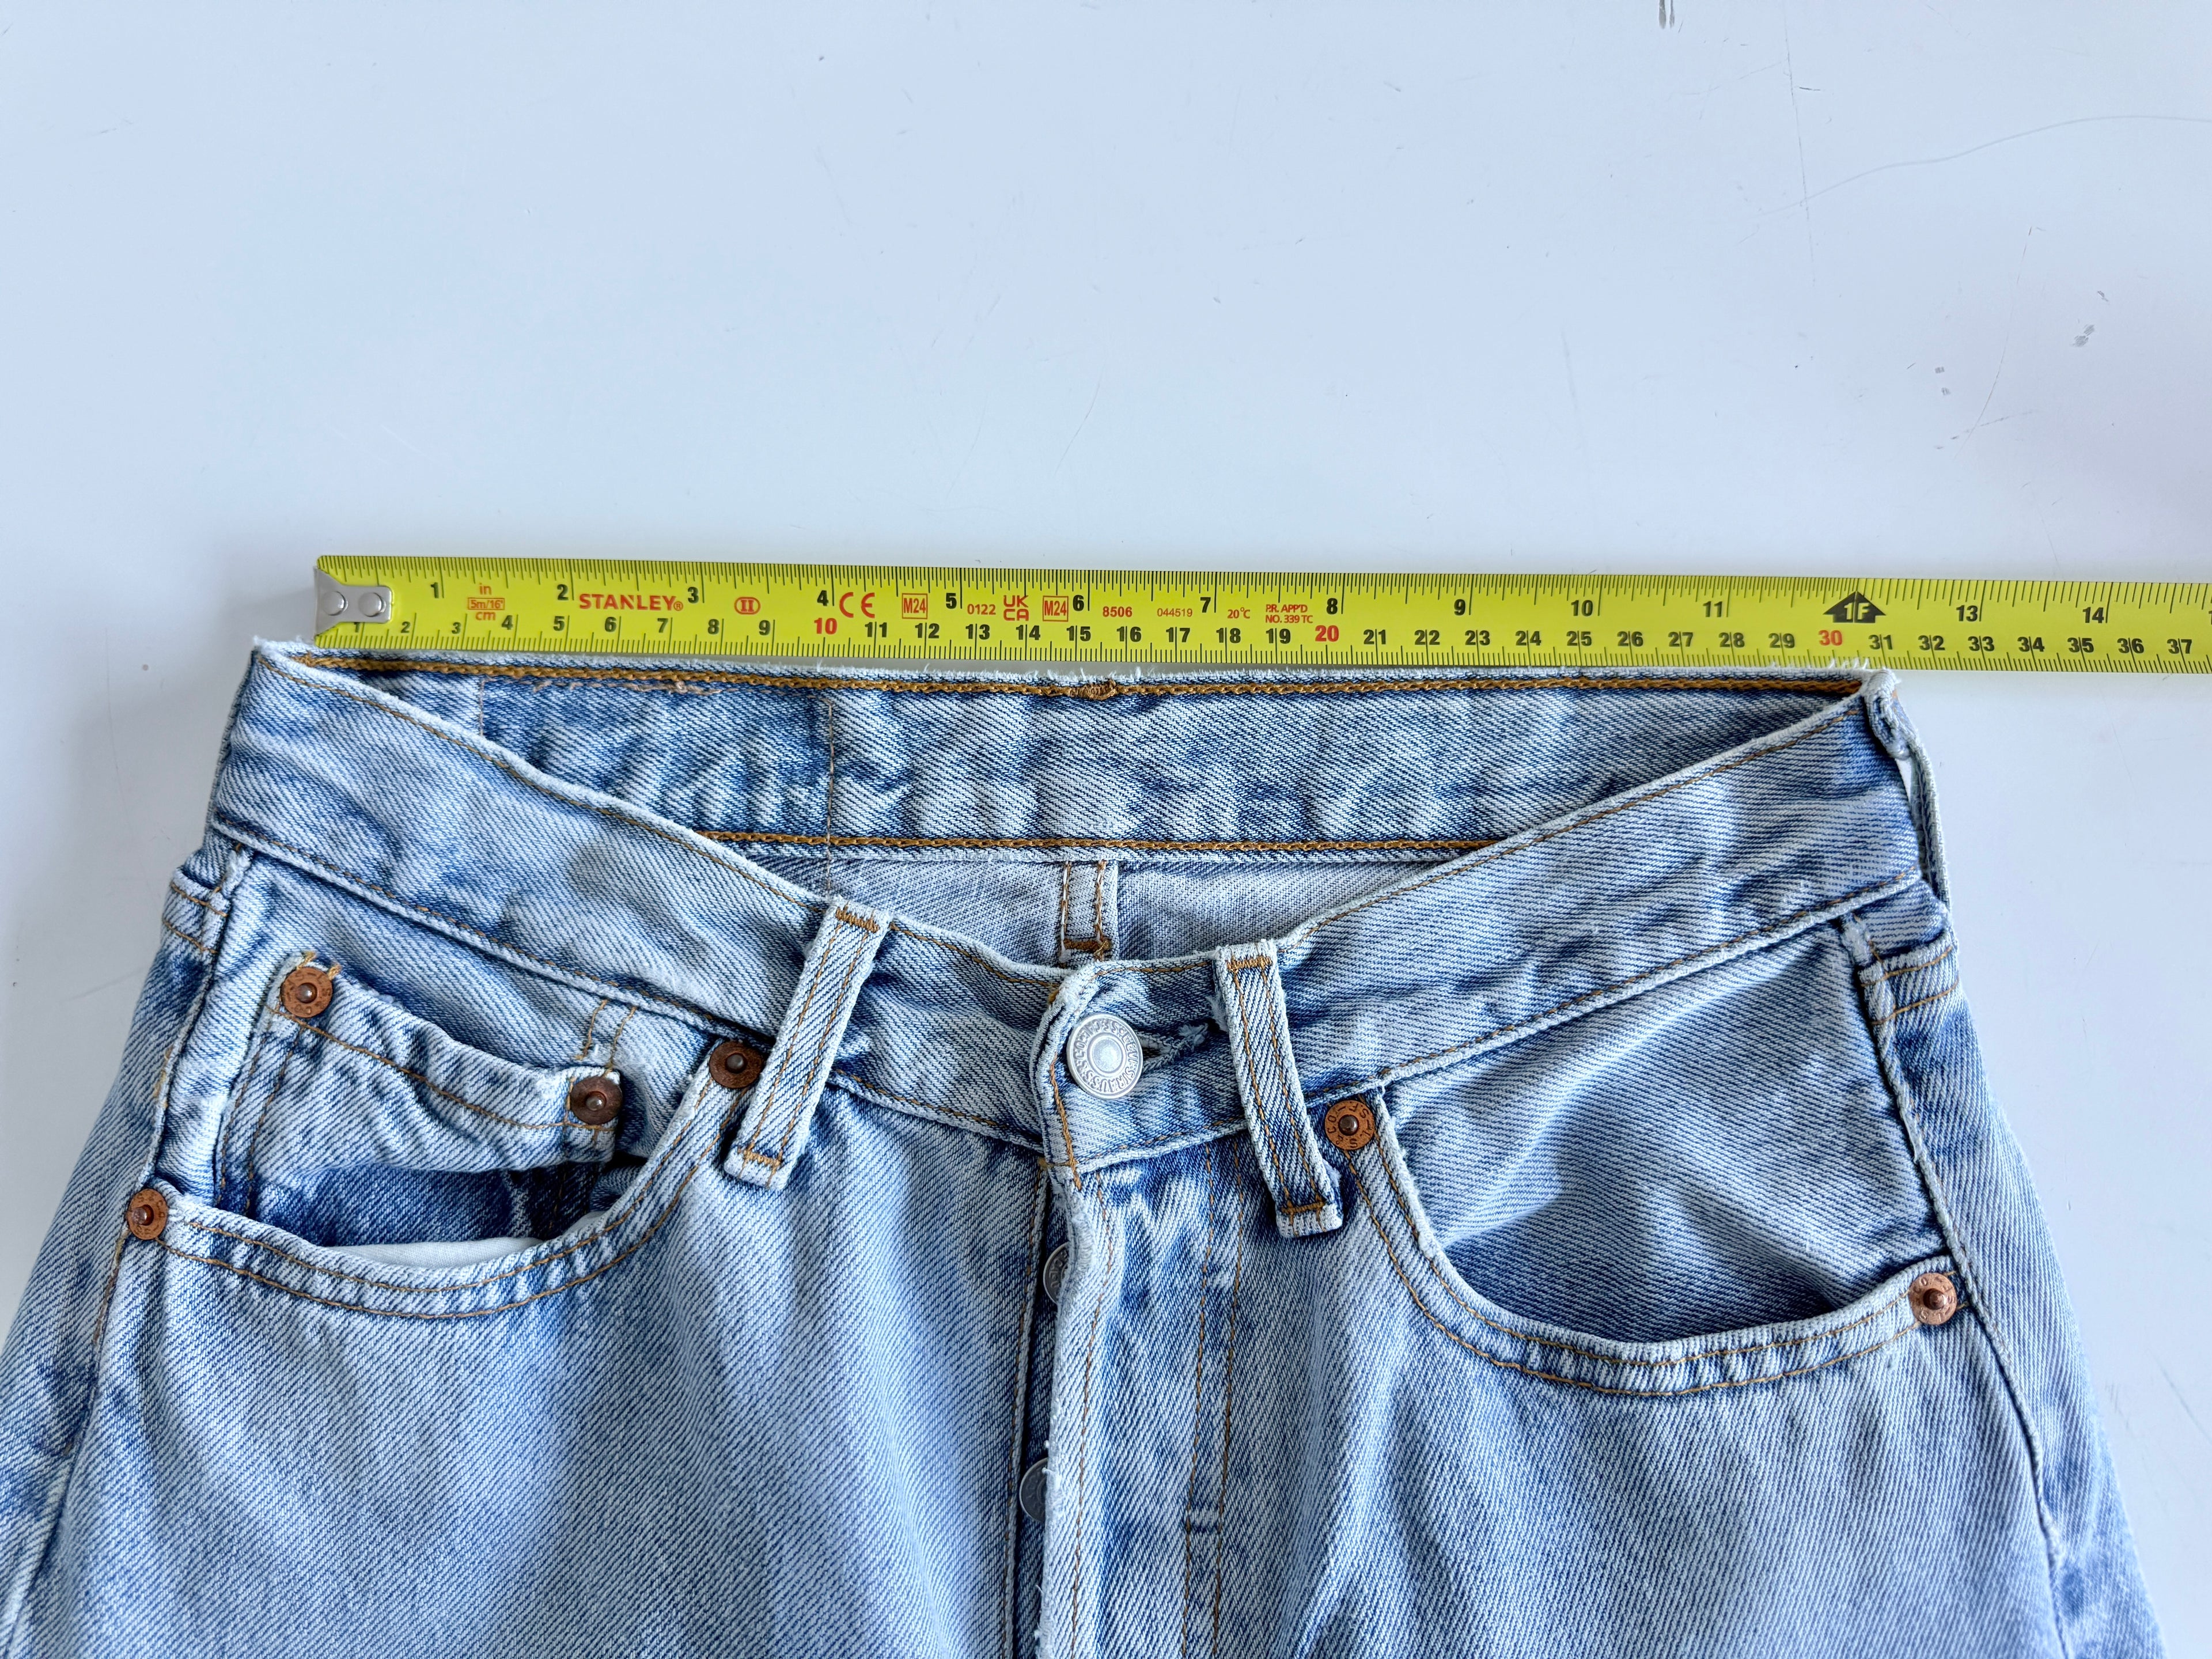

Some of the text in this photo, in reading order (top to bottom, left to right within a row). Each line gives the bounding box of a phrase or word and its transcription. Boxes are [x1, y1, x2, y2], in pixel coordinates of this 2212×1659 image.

[479, 582, 491, 594] in
[430, 582, 2104, 623] 1 2 3 4 5 6 7 8 9 10 11 1F 13 14
[839, 592, 876, 618] CE
[904, 598, 926, 613] M24
[1003, 595, 1029, 608] UK
[967, 604, 996, 615] 0122
[1044, 600, 1067, 616] M24
[1103, 607, 1132, 618] 8506
[1157, 608, 1193, 617] 044519
[475, 612, 496, 621] cm
[1003, 609, 1029, 621] CA
[1265, 615, 1313, 623] NO. 339 TC
[401, 622, 410, 633] 2
[452, 622, 461, 634] 3
[502, 615, 513, 630] 4
[553, 616, 565, 631] 5
[604, 617, 616, 632] 6
[657, 618, 668, 633] 7
[708, 619, 719, 634] 8
[759, 620, 771, 635] 9
[814, 618, 838, 634] 10
[865, 622, 887, 638] 11
[915, 623, 940, 638] 12
[965, 624, 990, 639] 13
[1016, 625, 1040, 640] 14
[1067, 626, 1091, 641] 15
[1116, 626, 1142, 642] 16
[1166, 627, 1190, 642] 17
[1216, 628, 1241, 643] 18
[1266, 628, 1291, 644] 19
[1315, 625, 1339, 642] 20
[1363, 630, 1386, 645] 21
[1414, 630, 1440, 645] 22
[1465, 630, 1490, 646] 23
[1516, 630, 1541, 646] 24
[1566, 631, 1592, 646] 25
[1617, 631, 1643, 647] 26
[1668, 632, 1694, 647] 27
[1719, 632, 1745, 647] 28
[1768, 632, 1795, 649] 29
[1819, 630, 1843, 646] 30
[1868, 634, 1893, 650] 31
[1918, 635, 1945, 651] 32
[1968, 636, 1995, 652] 33
[2017, 637, 2045, 652] 34
[2067, 637, 2094, 653] 35
[2117, 638, 2144, 654] 36
[2166, 639, 2192, 654] 37
